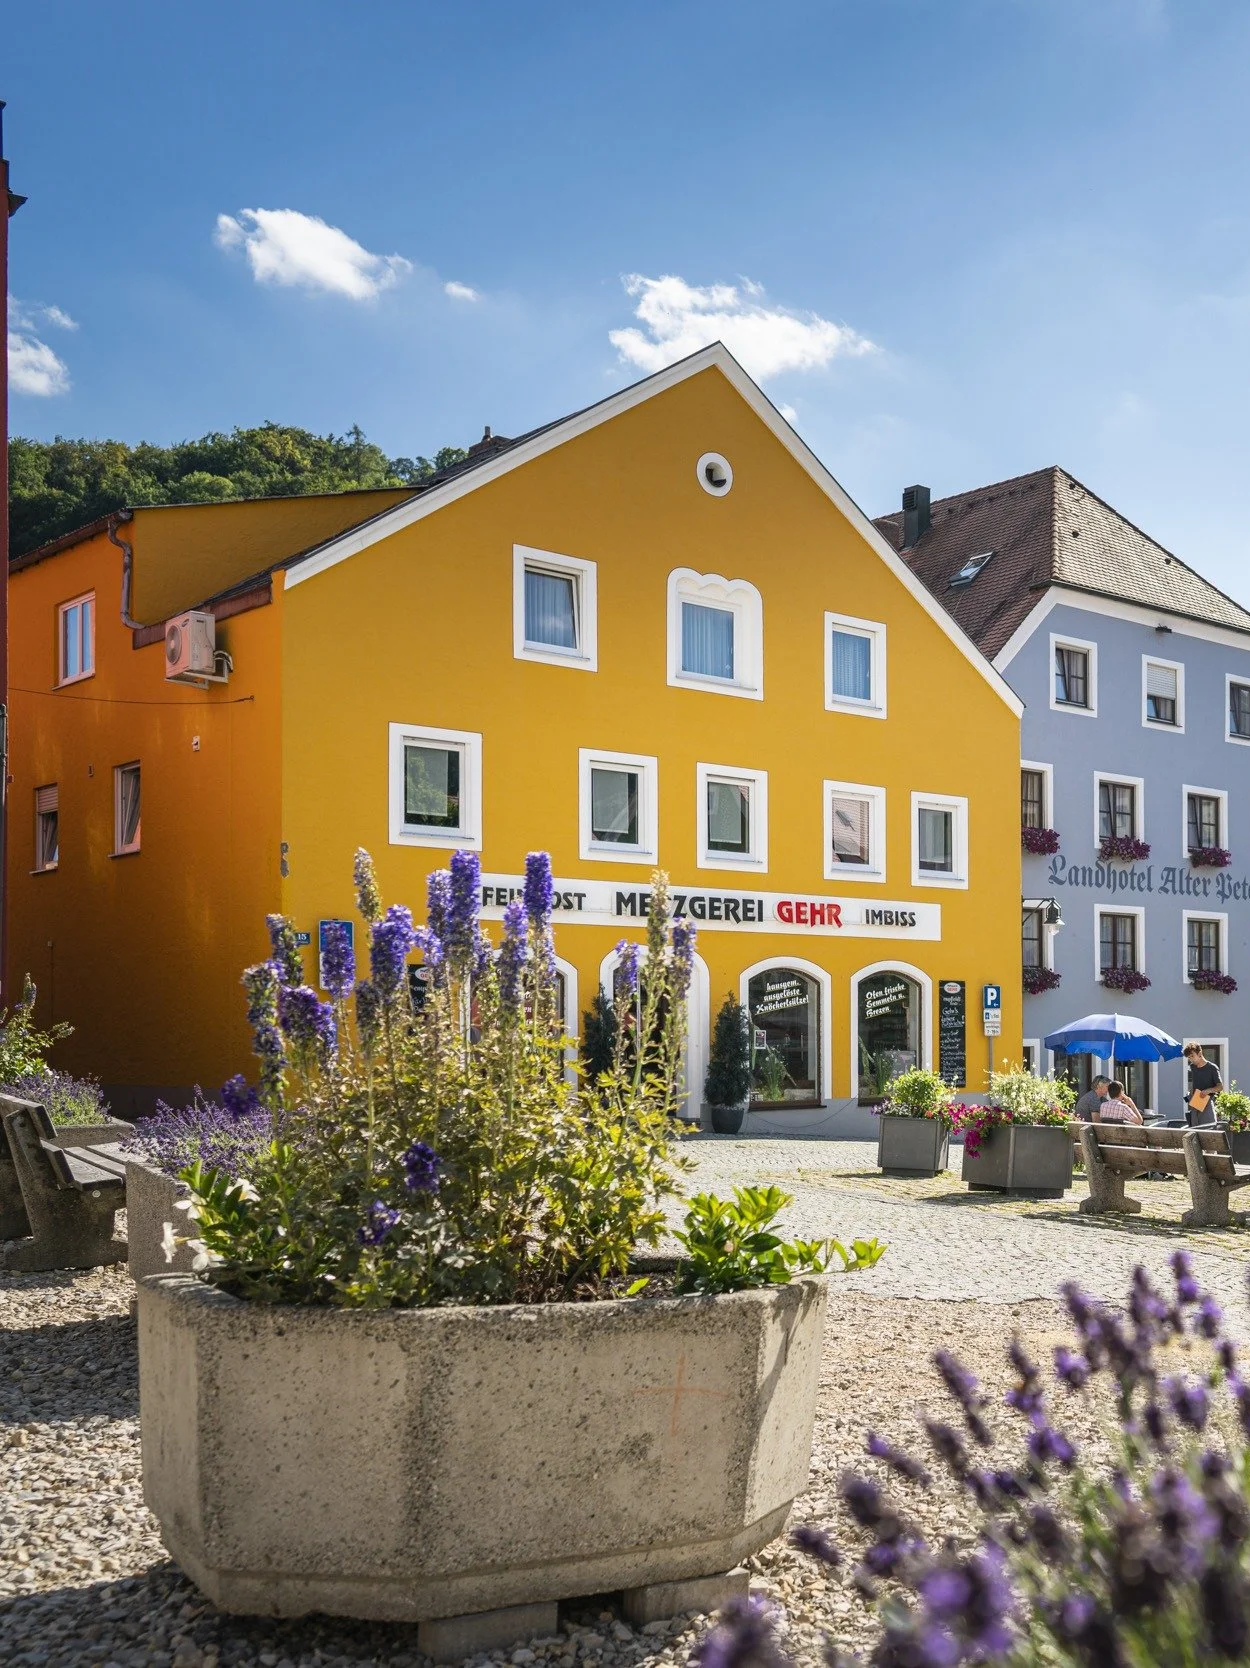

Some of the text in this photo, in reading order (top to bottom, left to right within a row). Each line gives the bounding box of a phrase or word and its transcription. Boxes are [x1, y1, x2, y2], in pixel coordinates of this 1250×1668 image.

[1048, 855, 1154, 894] Landhotel
[1158, 867, 1211, 897] Alter
[482, 886, 916, 928] FEIOST MEZGEREI GEHR IMBISS
[987, 988, 997, 1005] P
